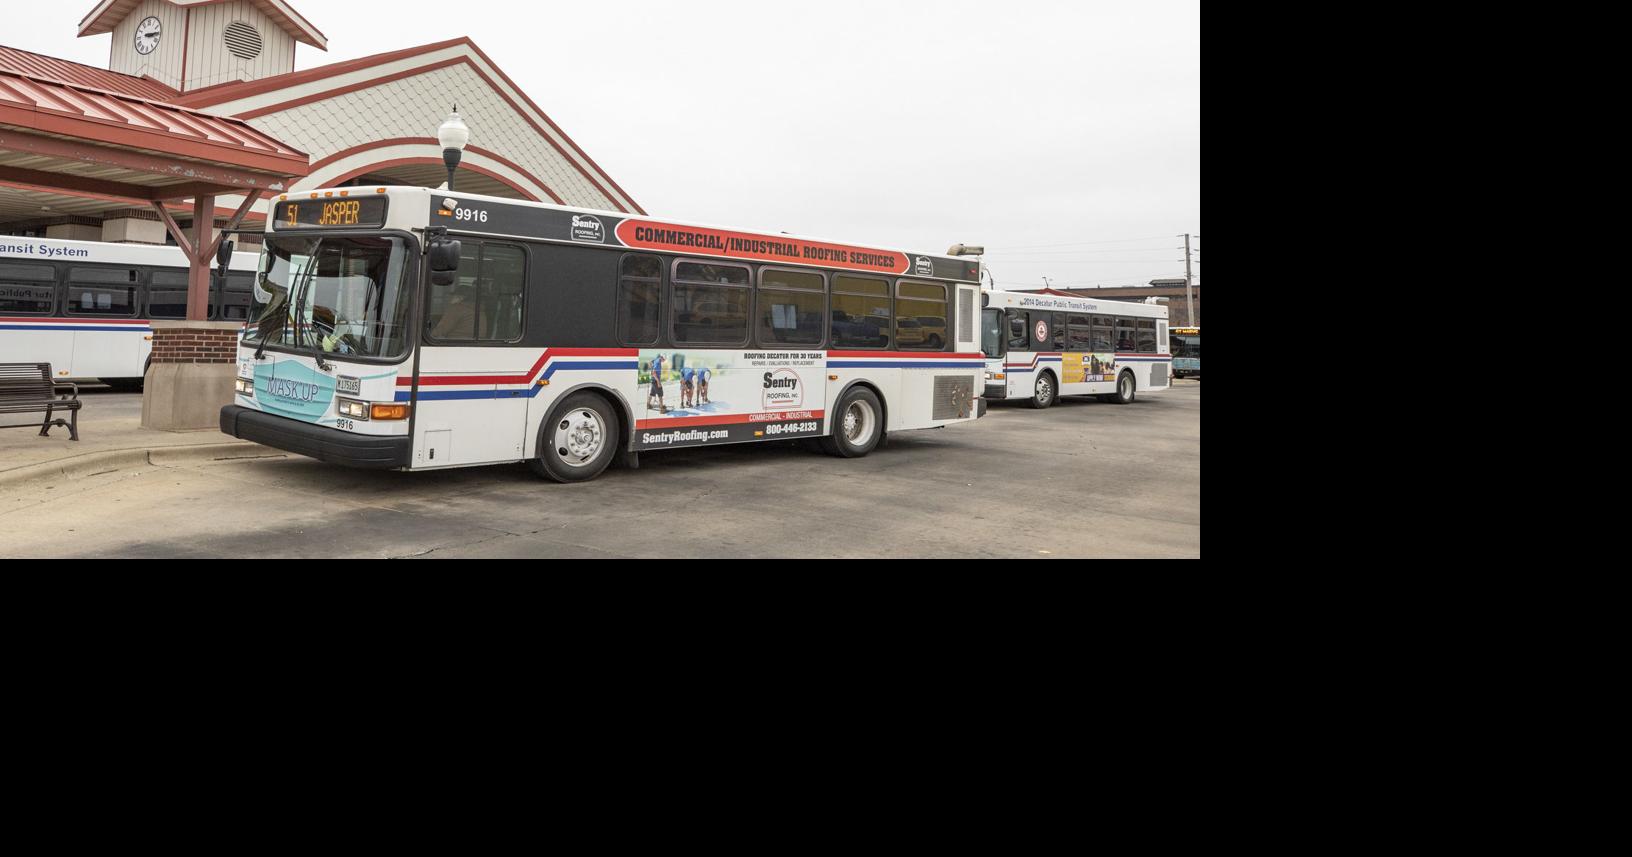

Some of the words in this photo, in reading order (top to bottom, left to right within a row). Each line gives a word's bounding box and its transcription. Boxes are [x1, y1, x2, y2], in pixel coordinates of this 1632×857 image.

[287, 204, 298, 226] 51
[319, 200, 360, 225] JASPER
[455, 208, 488, 222] 9916
[571, 215, 600, 231] Sentry
[39, 244, 89, 257] System
[803, 246, 847, 263] ROOFING
[850, 252, 895, 268] SERVICES
[1053, 300, 1067, 309] Public
[1068, 301, 1082, 310] Transit
[1082, 302, 1098, 311] System
[763, 371, 797, 390] Sentry
[267, 379, 300, 398] MASK
[302, 383, 319, 401] UP
[748, 412, 781, 421] COMMERCIAL
[786, 411, 812, 420] INDUSTRIAL
[336, 418, 354, 430] 9916
[766, 421, 817, 435] 800-446-2133
[642, 428, 729, 444] SentryRoofing.com
